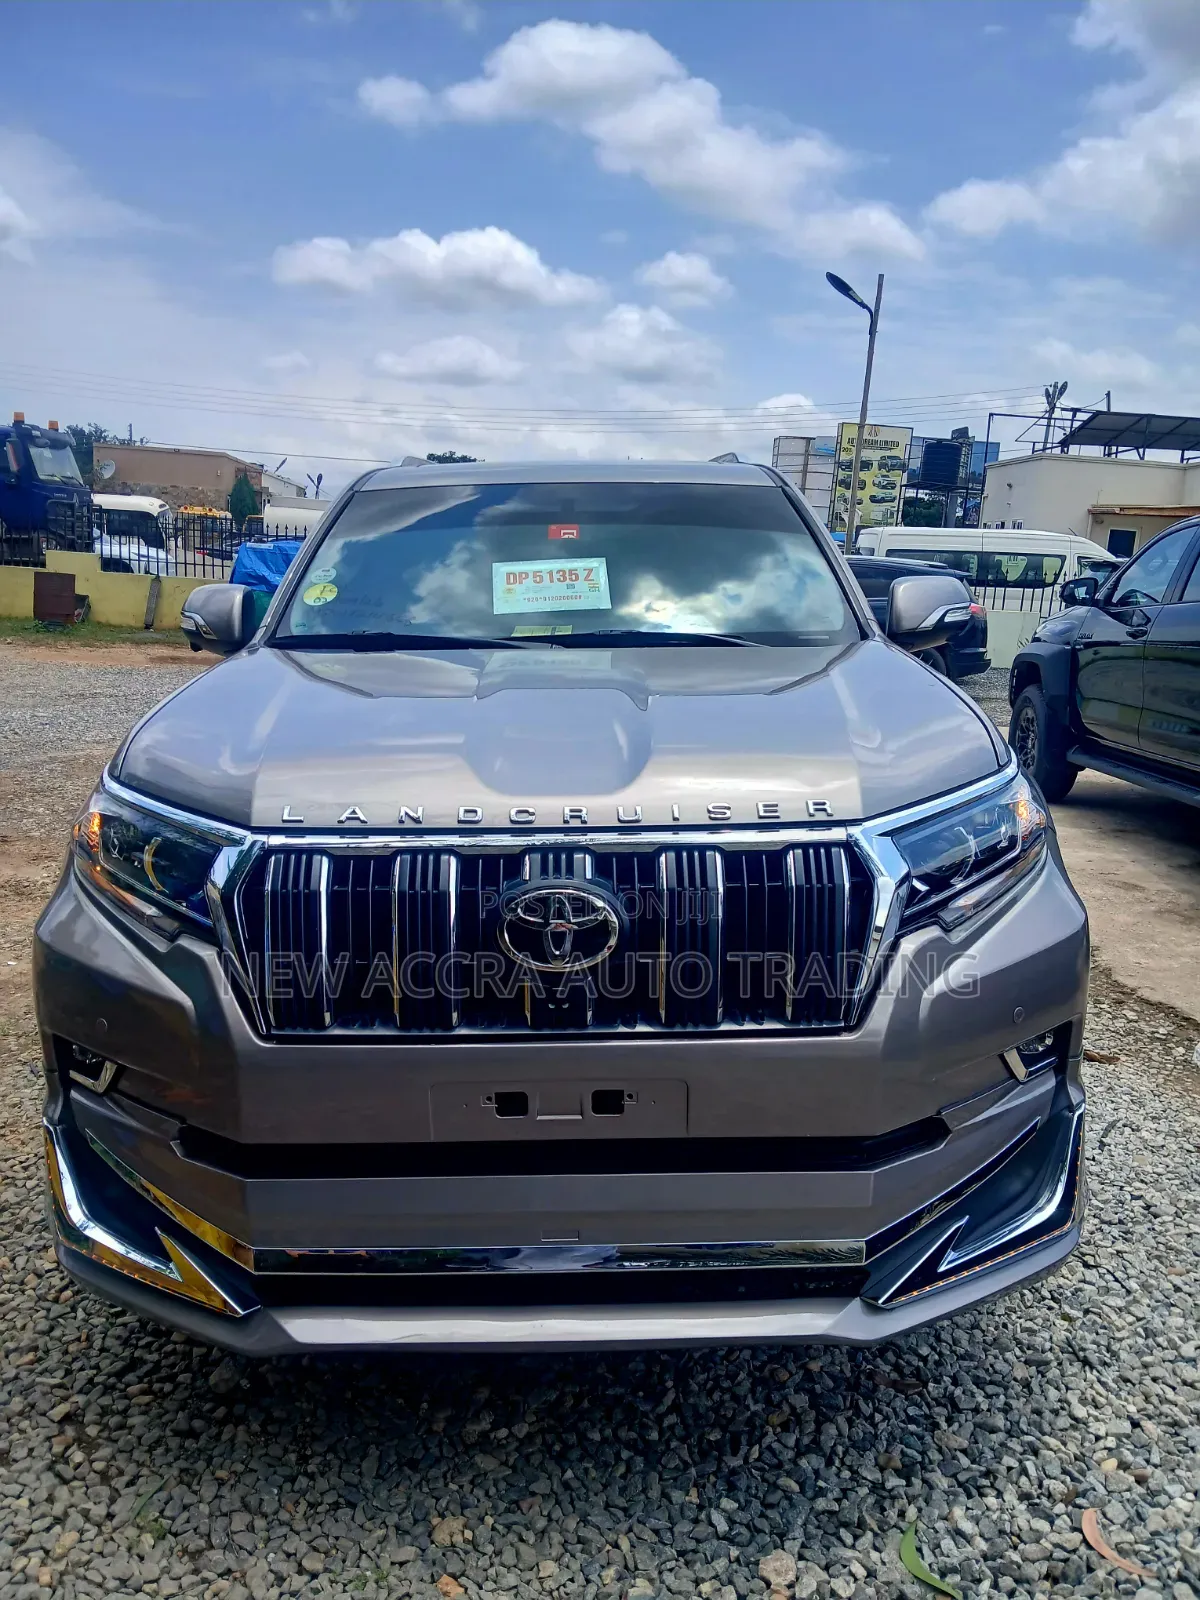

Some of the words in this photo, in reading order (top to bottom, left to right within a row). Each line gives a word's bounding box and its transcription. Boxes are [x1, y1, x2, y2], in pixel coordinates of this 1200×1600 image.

[506, 572, 529, 585] DP
[533, 569, 579, 584] 5135
[584, 568, 594, 582] Z
